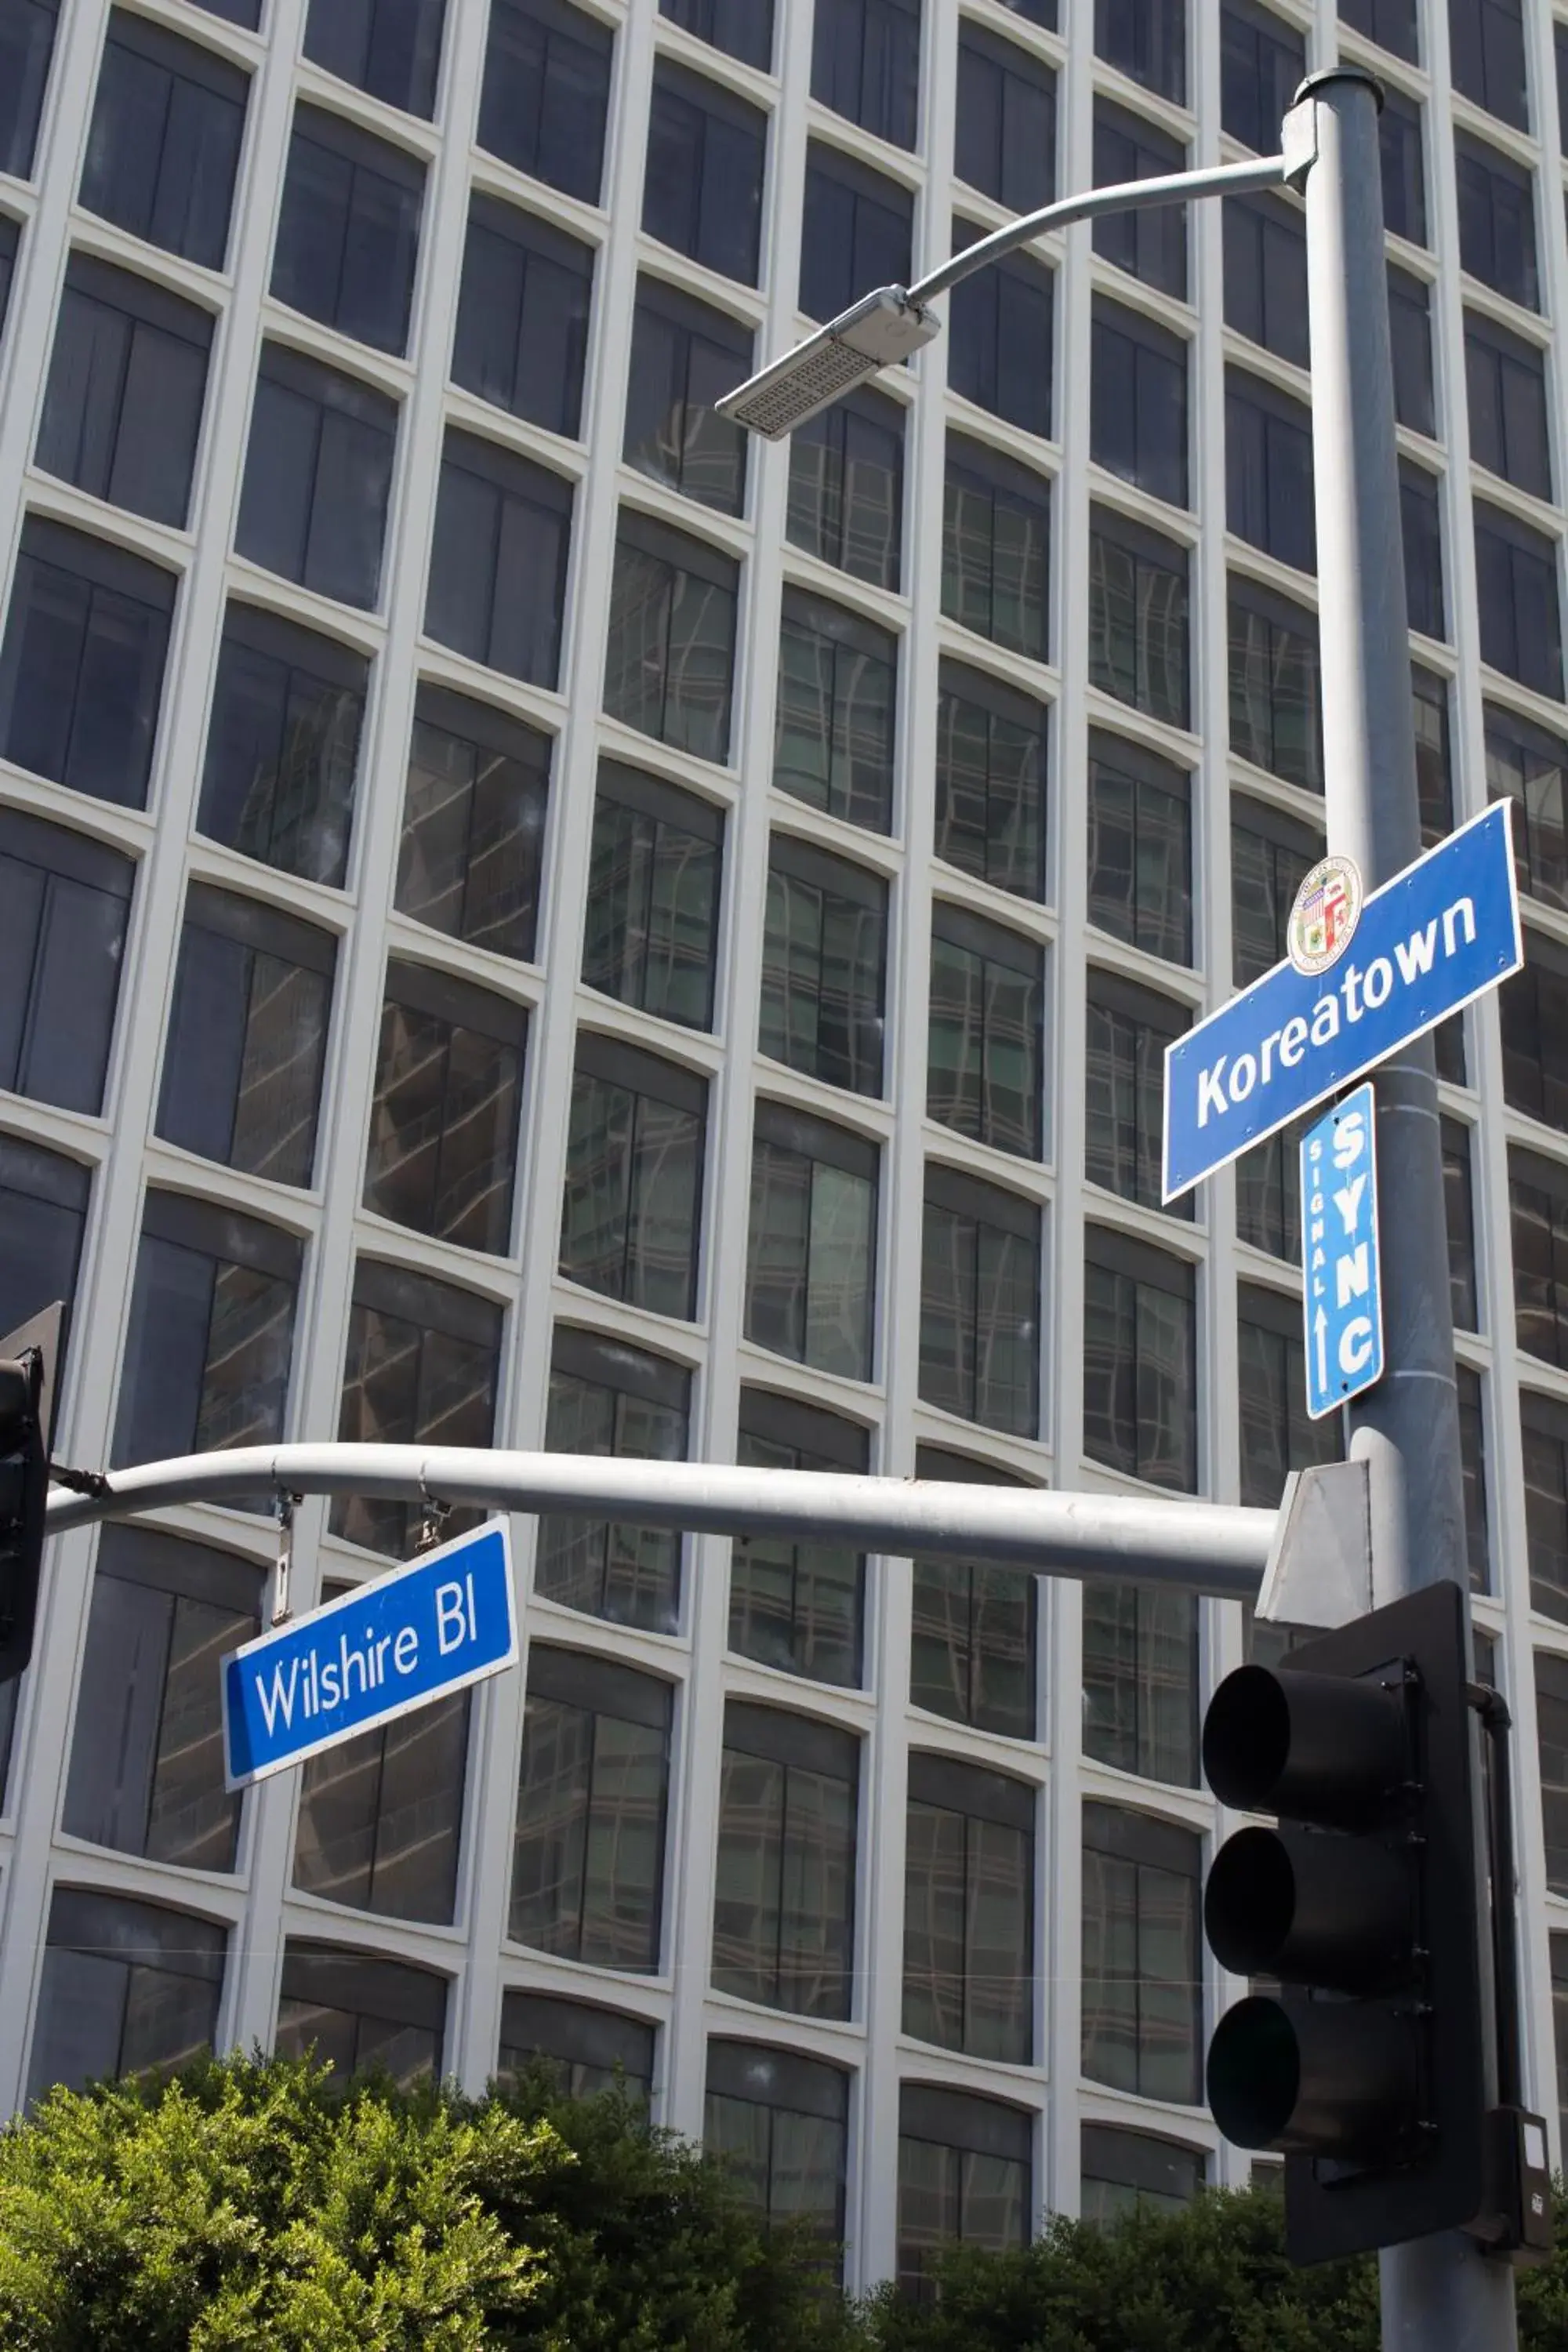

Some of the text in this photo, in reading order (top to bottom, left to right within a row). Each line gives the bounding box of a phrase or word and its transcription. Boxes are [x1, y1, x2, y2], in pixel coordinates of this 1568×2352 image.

[1197, 896, 1476, 1129] Koreatown
[1309, 1139, 1326, 1297] SIGNAL
[1333, 1112, 1372, 1374] SYNC
[256, 1573, 477, 1738] Wilshire Bl
